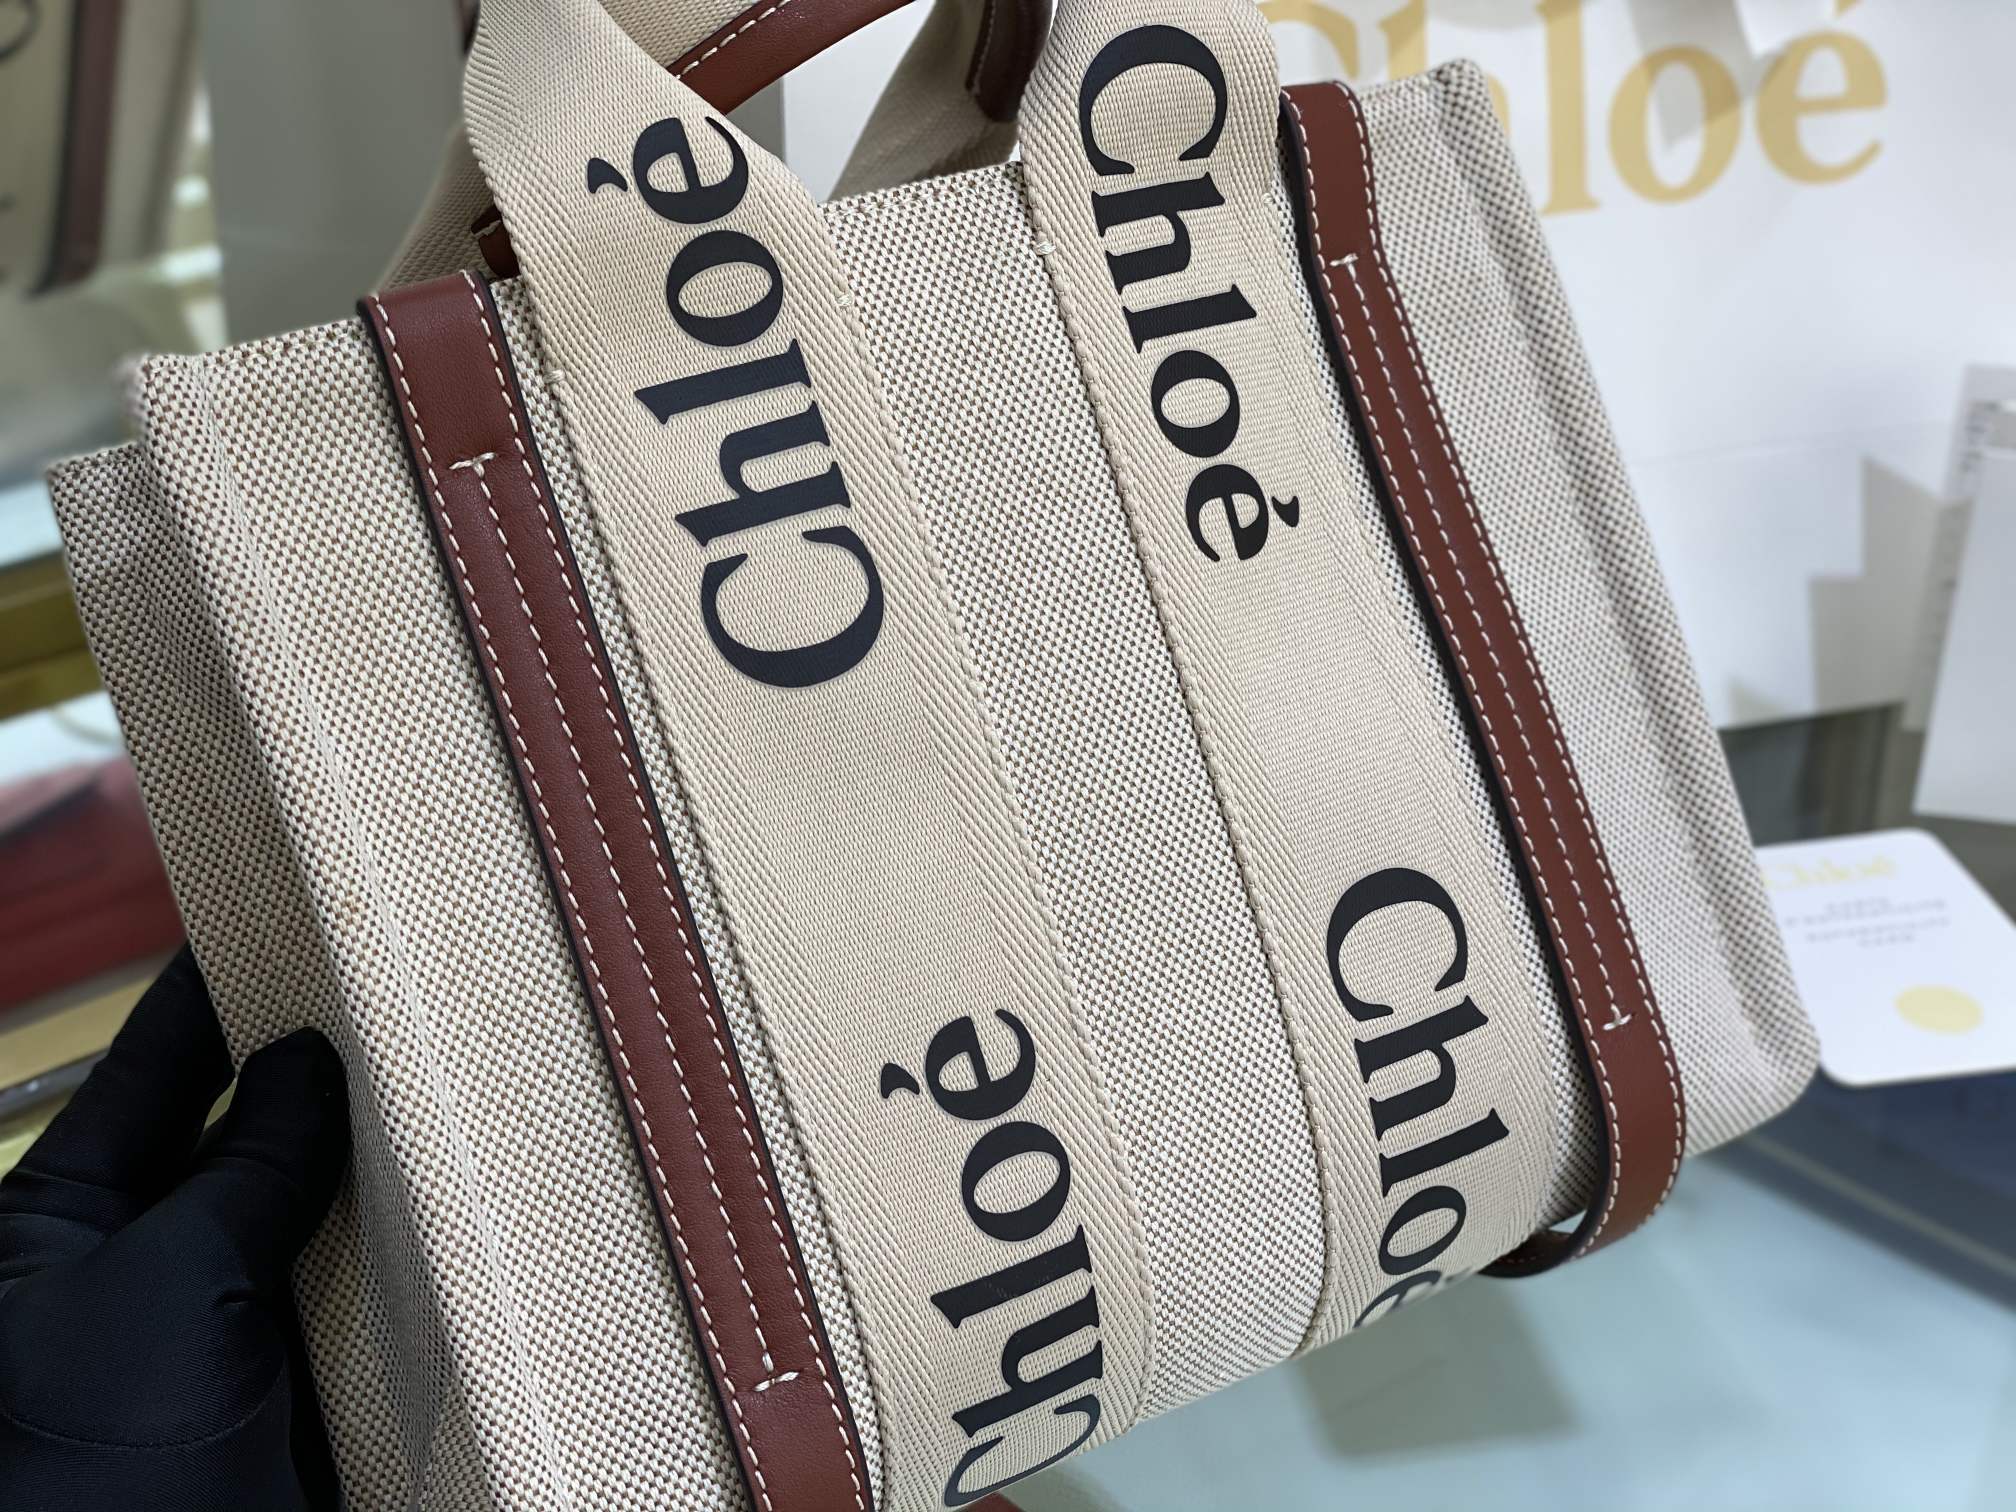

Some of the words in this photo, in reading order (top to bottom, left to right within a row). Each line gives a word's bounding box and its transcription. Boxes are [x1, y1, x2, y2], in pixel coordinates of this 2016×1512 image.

[587, 116, 884, 688] Chloé
[1079, 24, 1300, 562] Chloé
[881, 1008, 1103, 1507] Chloé
